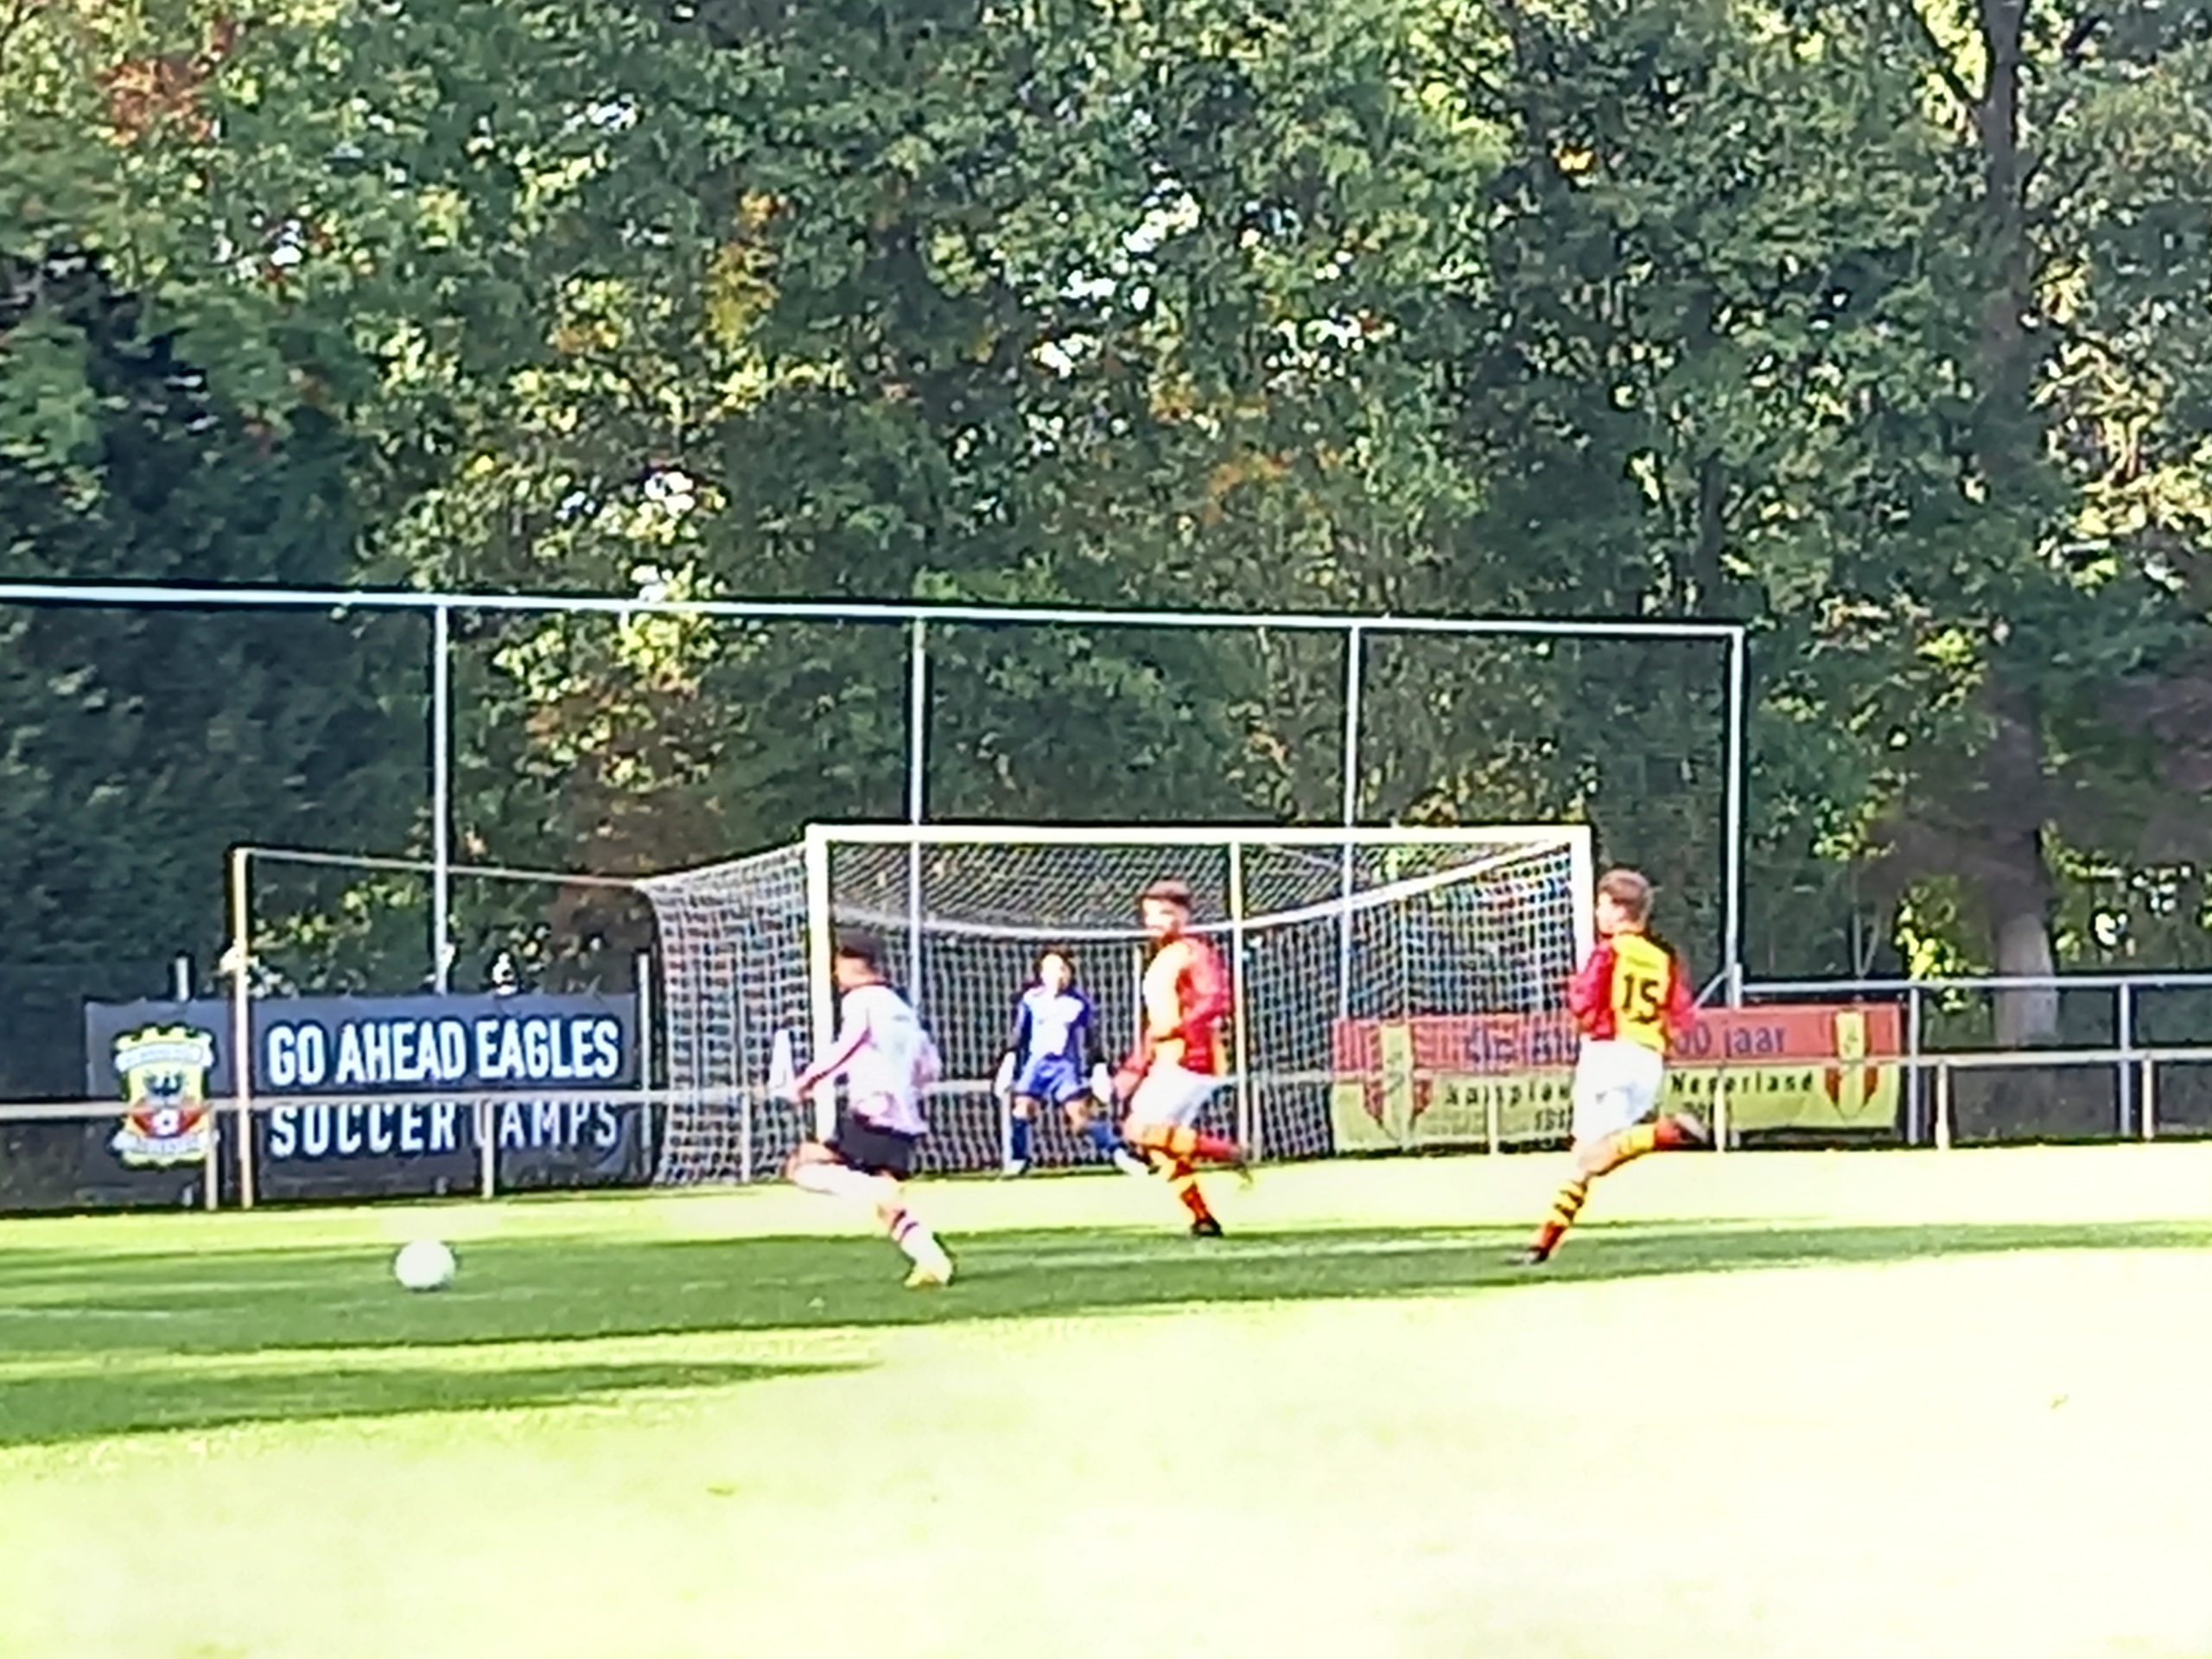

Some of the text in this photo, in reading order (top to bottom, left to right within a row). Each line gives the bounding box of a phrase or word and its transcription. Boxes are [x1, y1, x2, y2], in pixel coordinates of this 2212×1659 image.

[1622, 973, 1660, 1025] 15
[269, 1025, 325, 1086] GO
[336, 1021, 467, 1084] AHEAD
[476, 1019, 619, 1078] EAGLES
[1724, 1020, 1786, 1058] jaar
[270, 1104, 455, 1156] SOCCER
